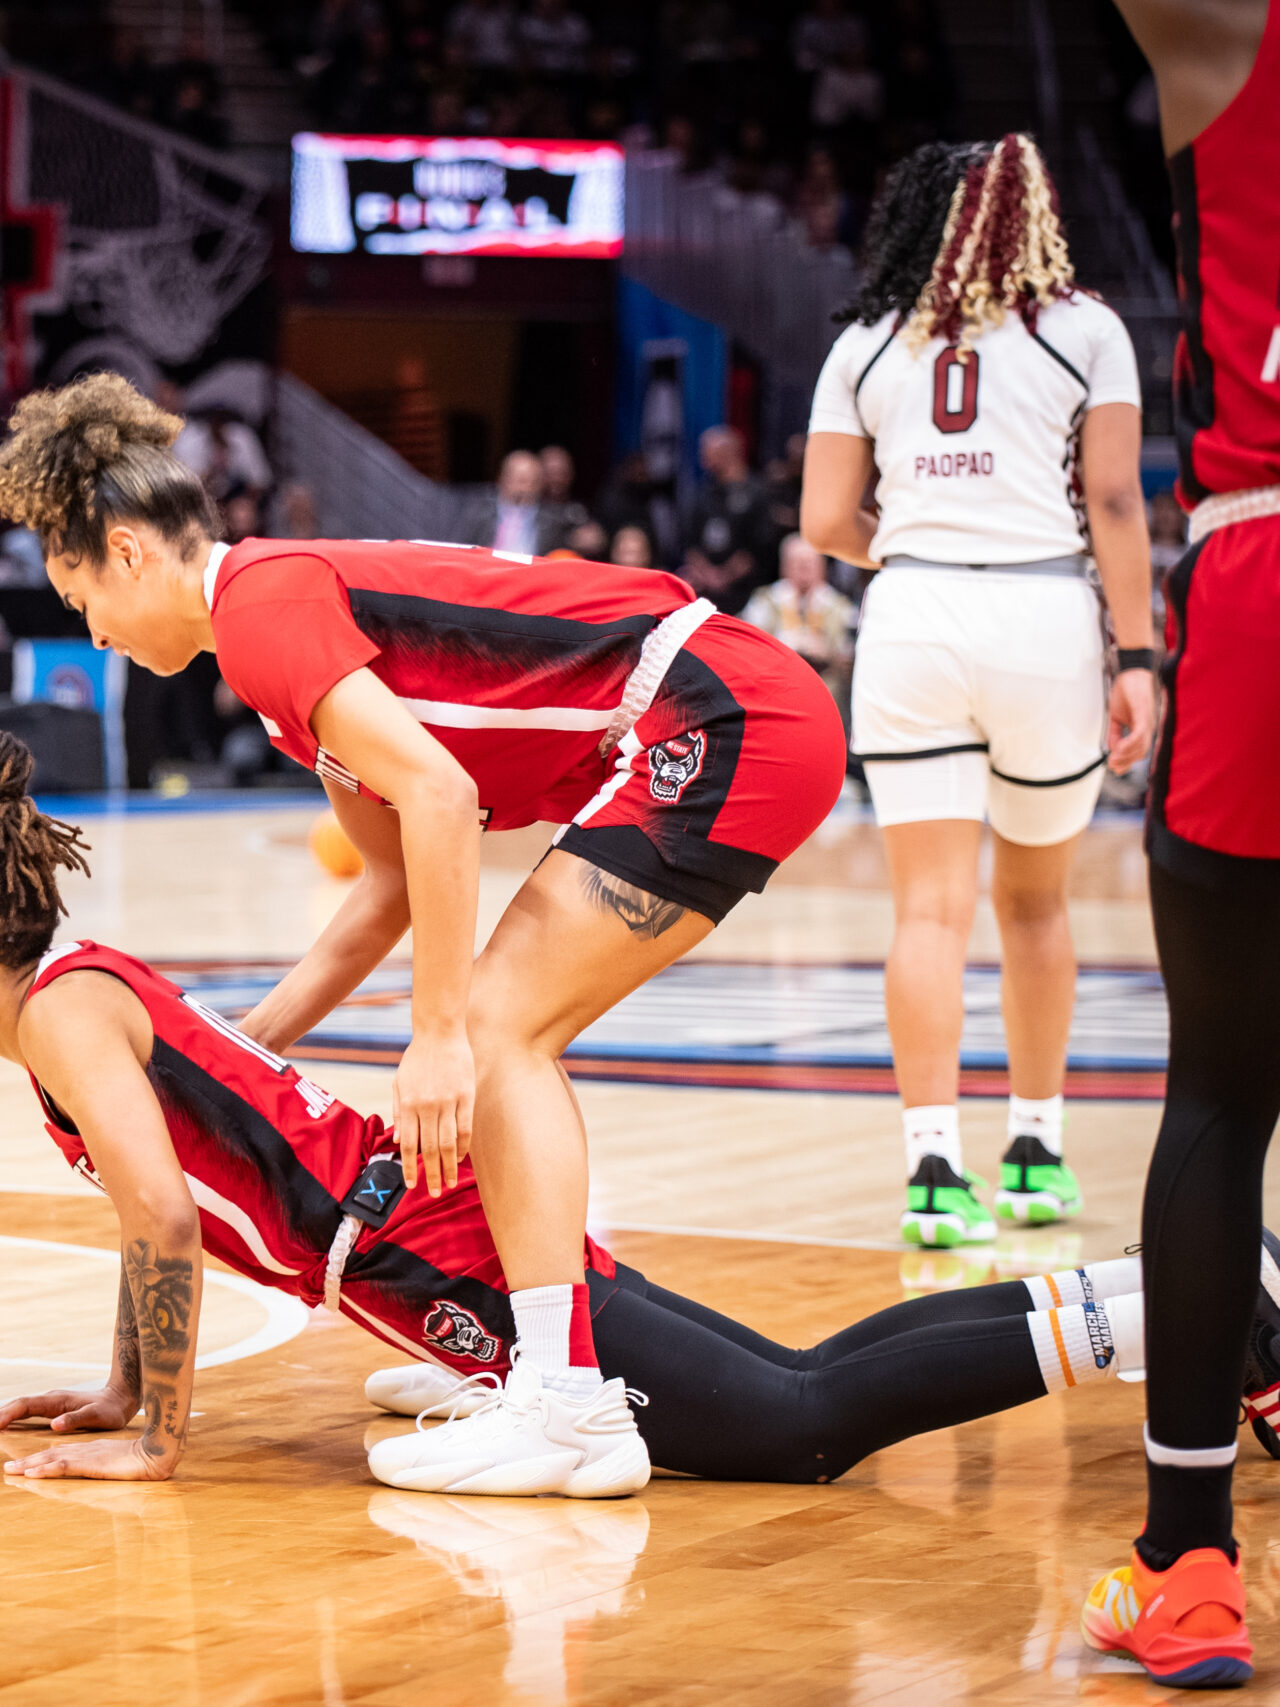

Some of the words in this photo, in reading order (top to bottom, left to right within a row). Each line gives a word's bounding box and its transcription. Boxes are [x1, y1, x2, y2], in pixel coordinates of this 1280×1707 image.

[932, 345, 979, 434] 0
[915, 452, 993, 479] PAOPAO
[1085, 1311, 1107, 1356] MARCH
[1095, 1301, 1114, 1348] MADNES
